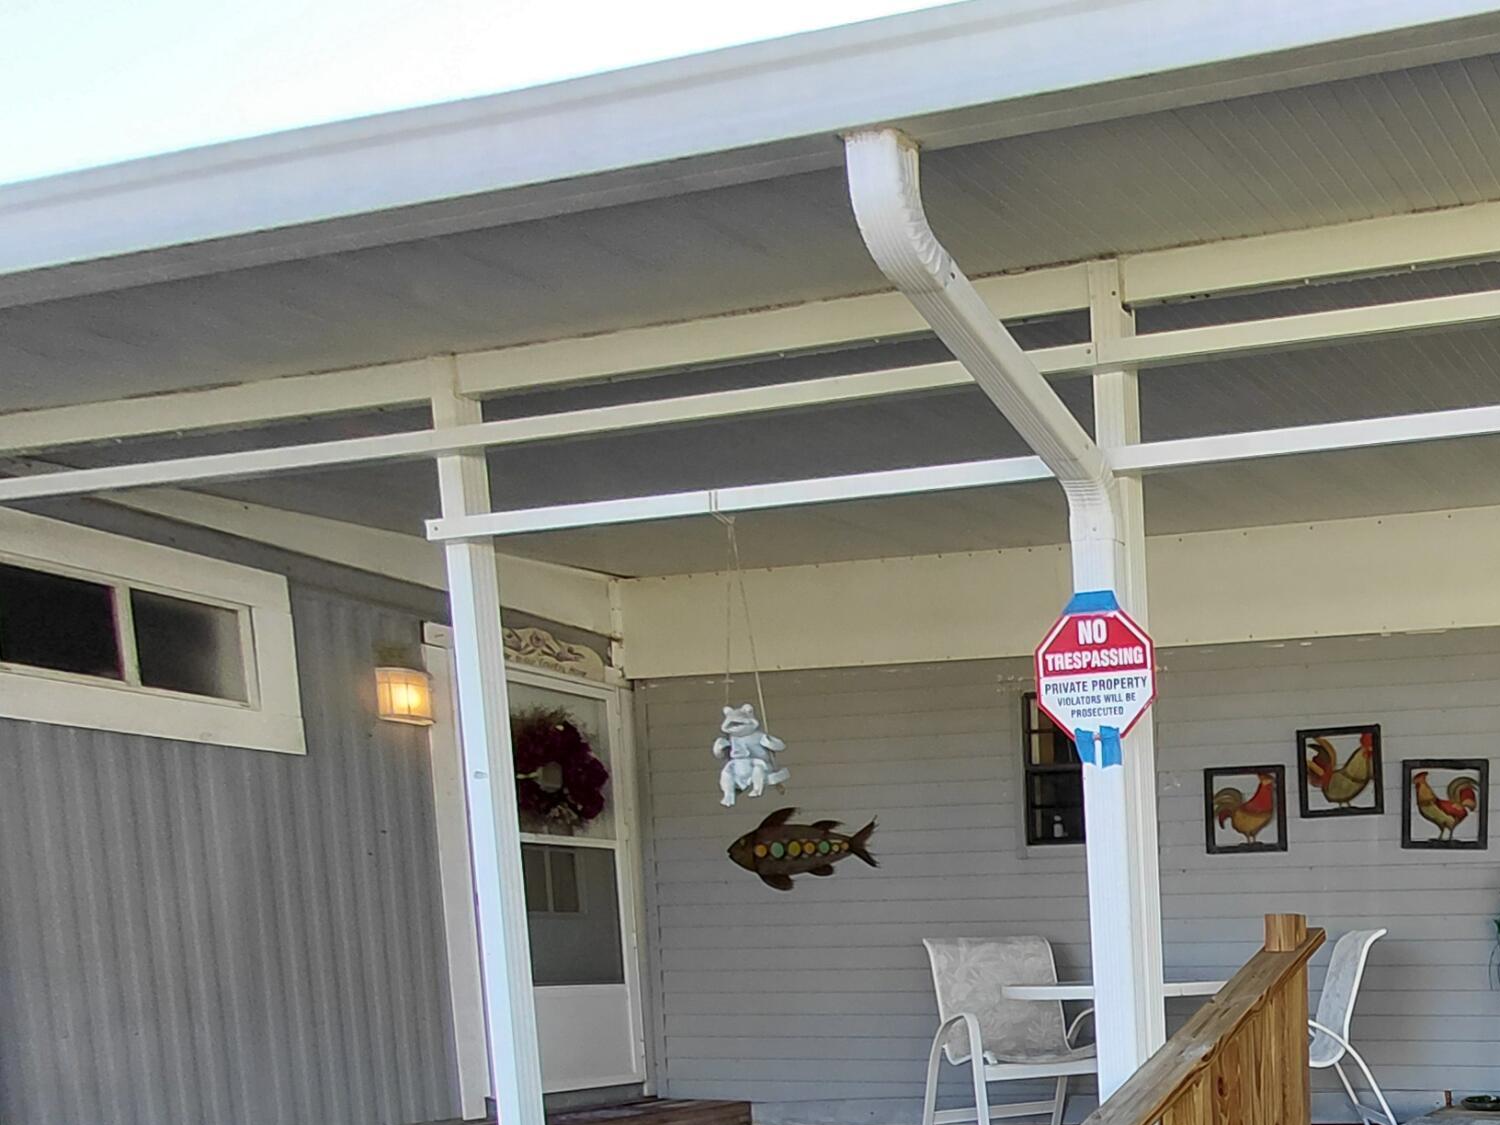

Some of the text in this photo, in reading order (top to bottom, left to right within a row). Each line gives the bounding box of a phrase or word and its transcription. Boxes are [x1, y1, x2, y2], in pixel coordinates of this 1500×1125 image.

[1077, 618, 1108, 645] NO
[1045, 646, 1144, 672] TRESPASSING
[1045, 675, 1148, 695] PRIVATE PROPERTY
[1057, 692, 1136, 707] VIOLATORS WILL BE
[1071, 706, 1124, 718] PROSECUTED
